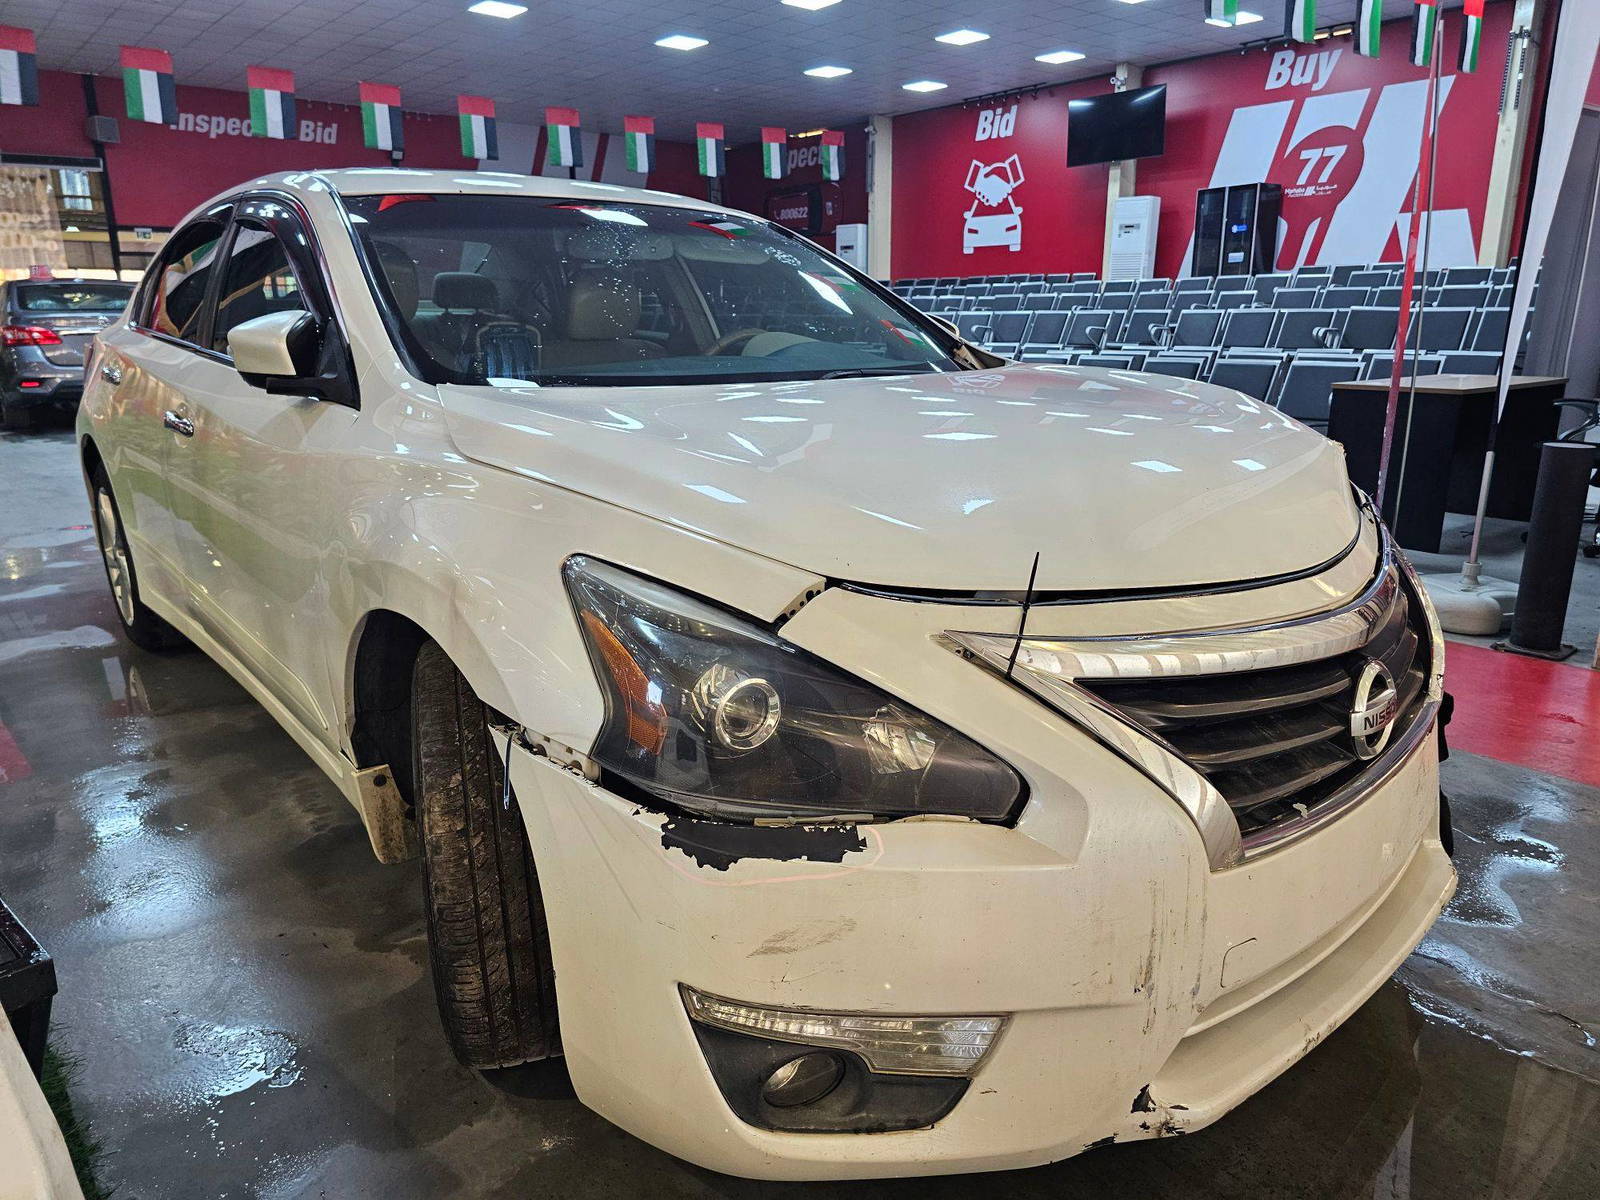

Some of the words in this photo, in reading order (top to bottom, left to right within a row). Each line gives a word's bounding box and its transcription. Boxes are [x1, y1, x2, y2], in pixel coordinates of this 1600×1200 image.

[1265, 48, 1343, 92] Buy
[170, 112, 253, 139] nspec
[300, 119, 338, 144] Bid
[975, 104, 1018, 142] Bid
[1296, 144, 1348, 186] 77
